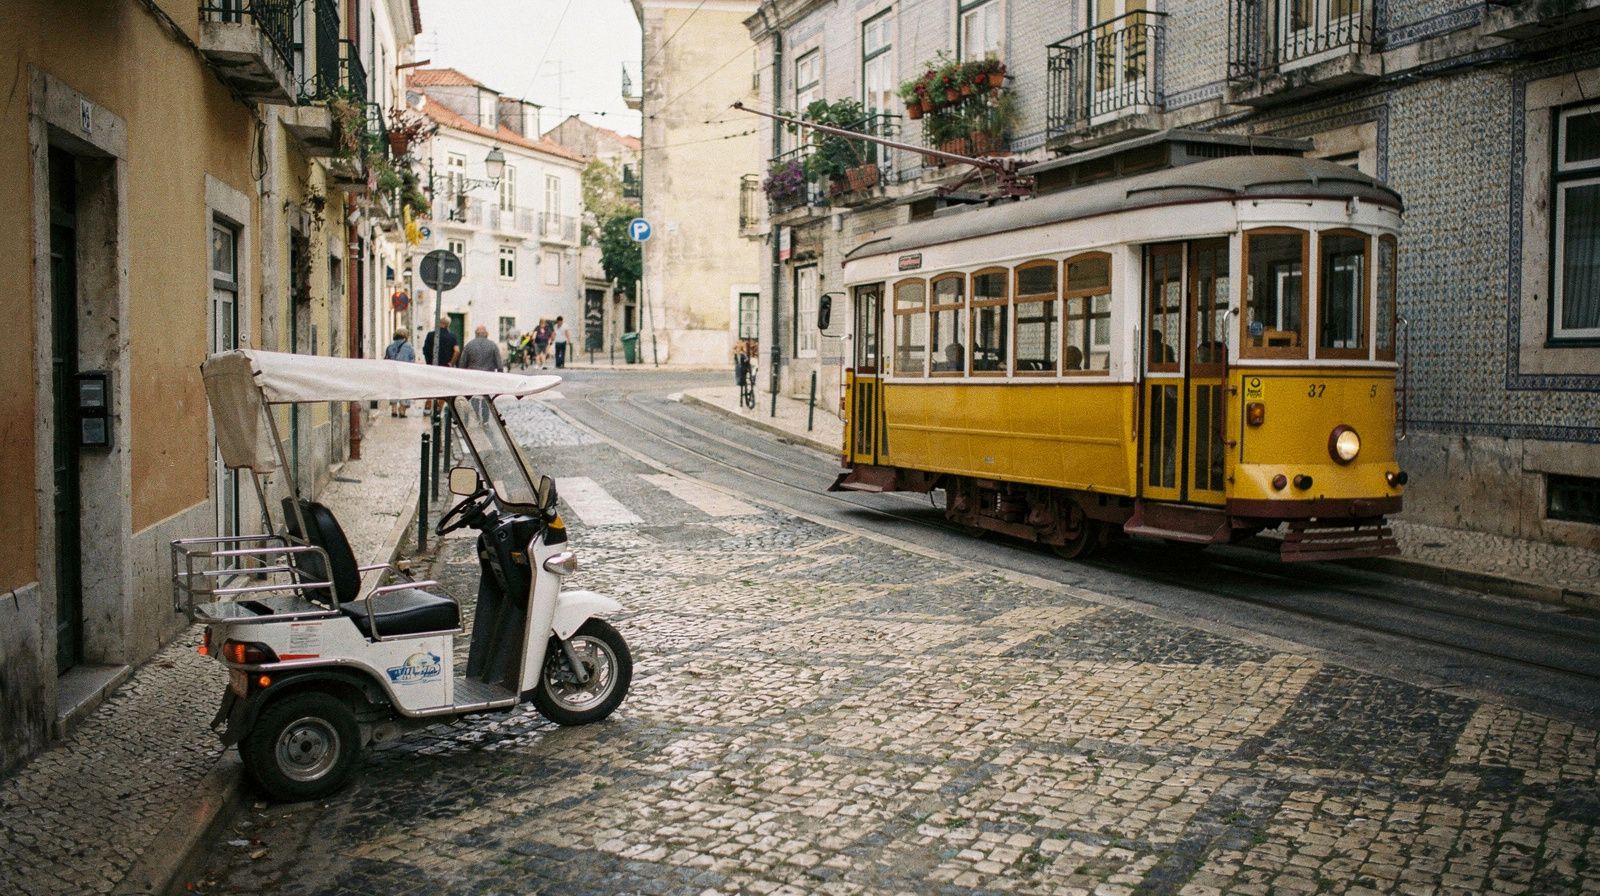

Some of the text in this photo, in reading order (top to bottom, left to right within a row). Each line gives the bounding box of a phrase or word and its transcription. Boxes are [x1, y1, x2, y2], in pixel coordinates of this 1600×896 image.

[634, 222, 648, 240] P
[1308, 383, 1326, 398] 37
[1370, 384, 1378, 398] 5
